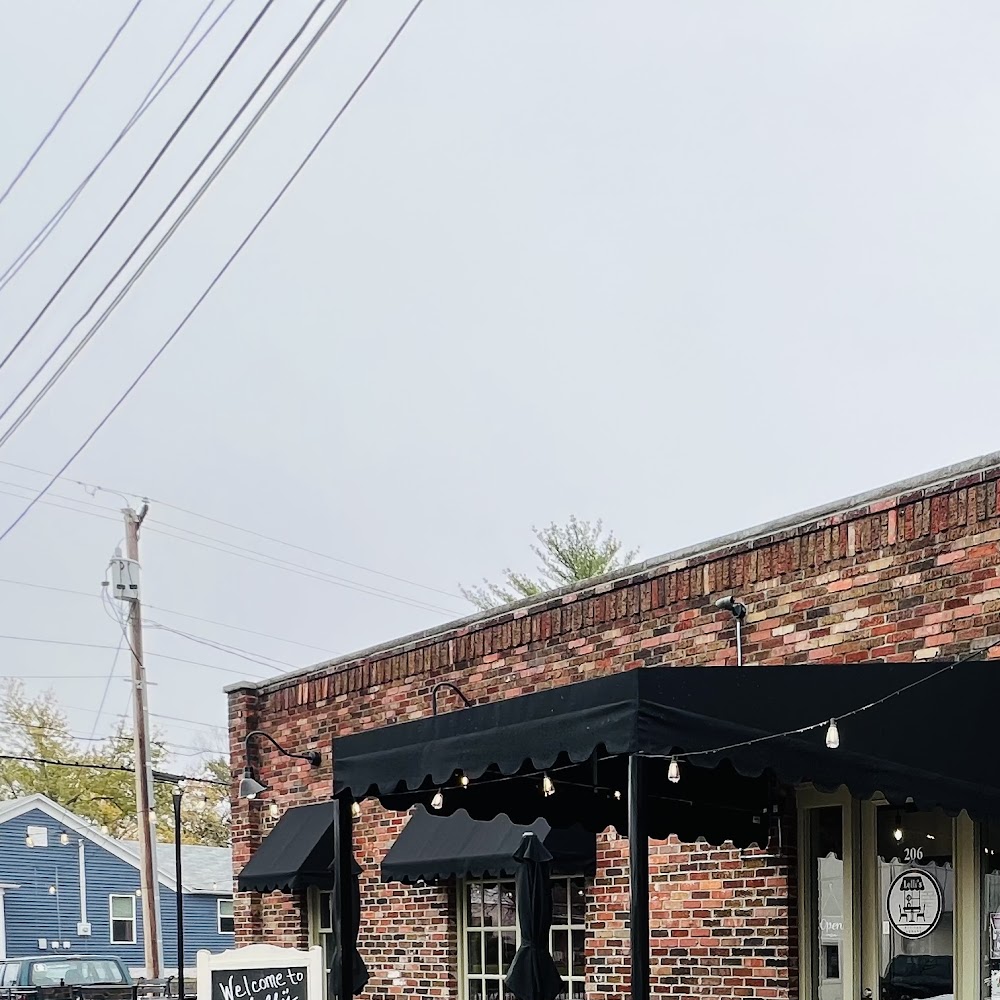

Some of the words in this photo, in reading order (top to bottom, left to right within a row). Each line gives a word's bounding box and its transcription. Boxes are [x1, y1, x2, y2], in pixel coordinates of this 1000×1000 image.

[904, 847, 923, 861] 206
[820, 918, 843, 931] Open
[286, 968, 304, 985] to
